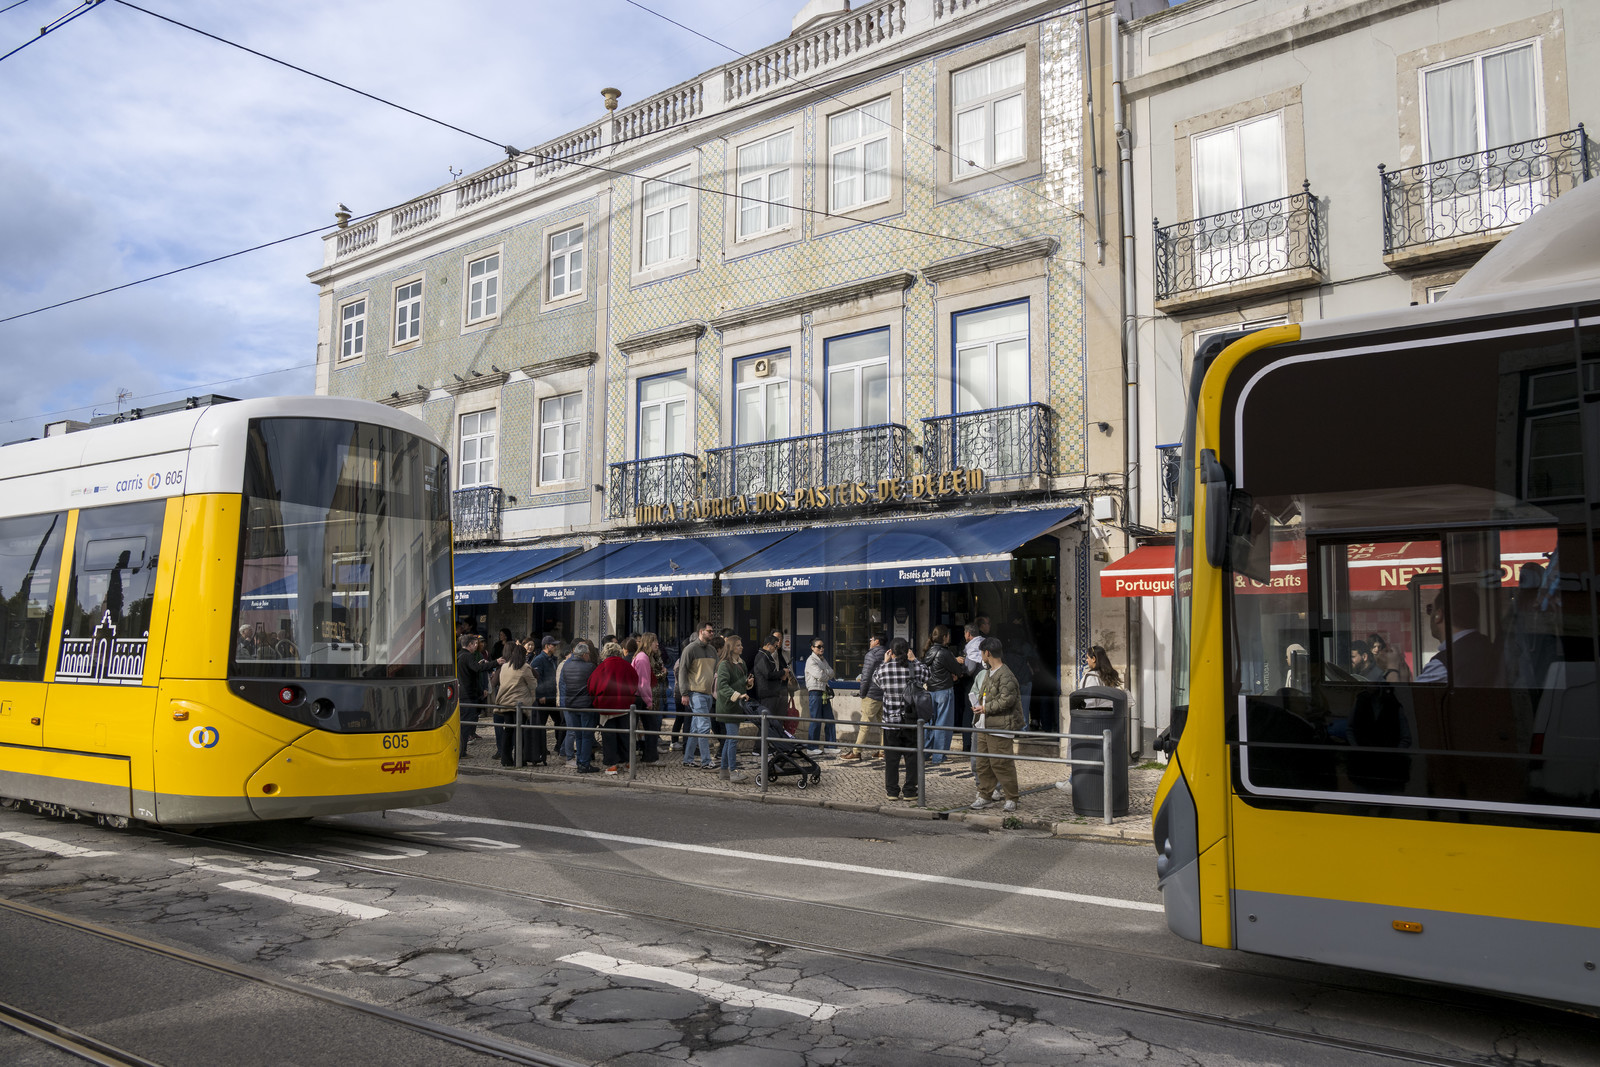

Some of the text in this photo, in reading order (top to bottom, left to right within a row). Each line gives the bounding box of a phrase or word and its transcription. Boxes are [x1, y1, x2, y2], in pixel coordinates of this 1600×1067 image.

[116, 470, 183, 492] carris 605
[756, 490, 787, 513] DOS
[877, 477, 903, 502] DE
[1235, 575, 1247, 588] &
[382, 734, 409, 750] 605
[381, 760, 411, 775] CAF
